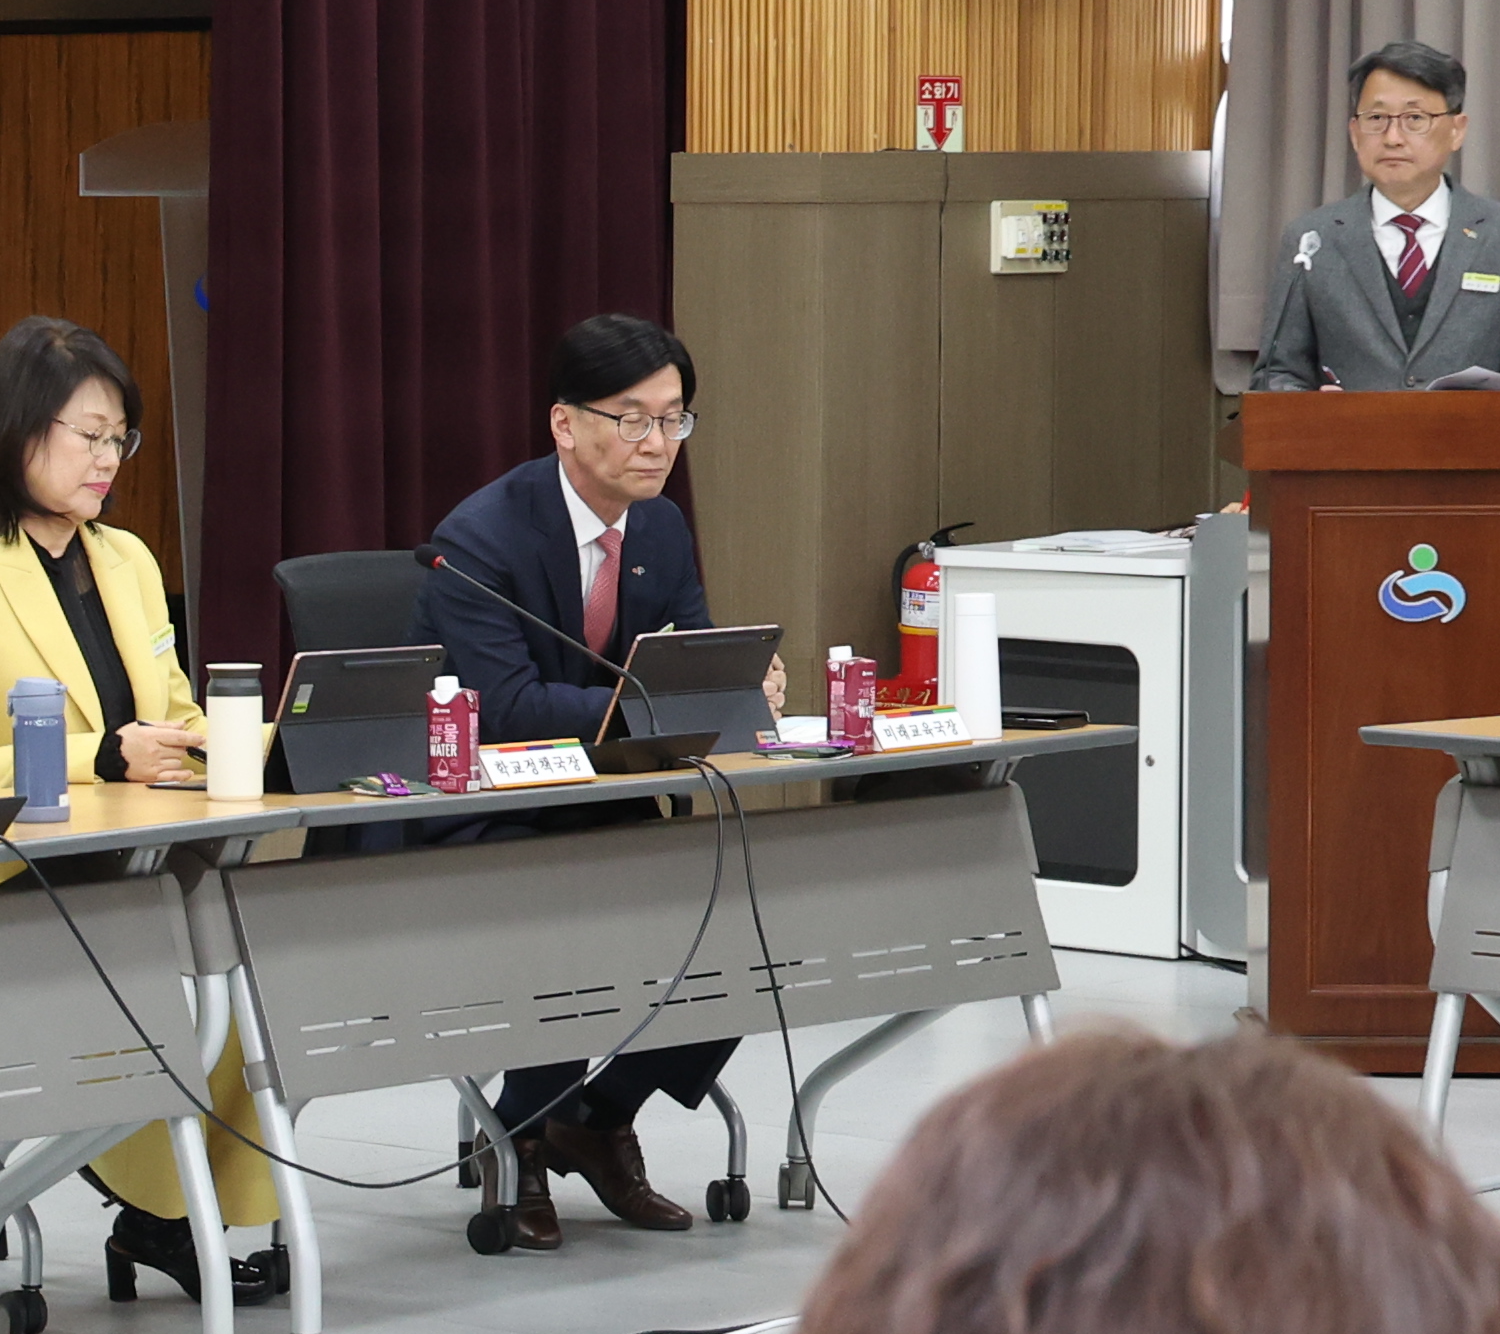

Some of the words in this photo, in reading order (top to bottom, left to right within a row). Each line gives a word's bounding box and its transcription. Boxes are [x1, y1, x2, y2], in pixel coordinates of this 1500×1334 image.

[921, 82, 959, 99] 소화기
[443, 723, 459, 743] 물
[883, 719, 959, 743] 미래교육국장
[429, 743, 458, 758] WATER
[494, 753, 581, 778] 학교정책국장
